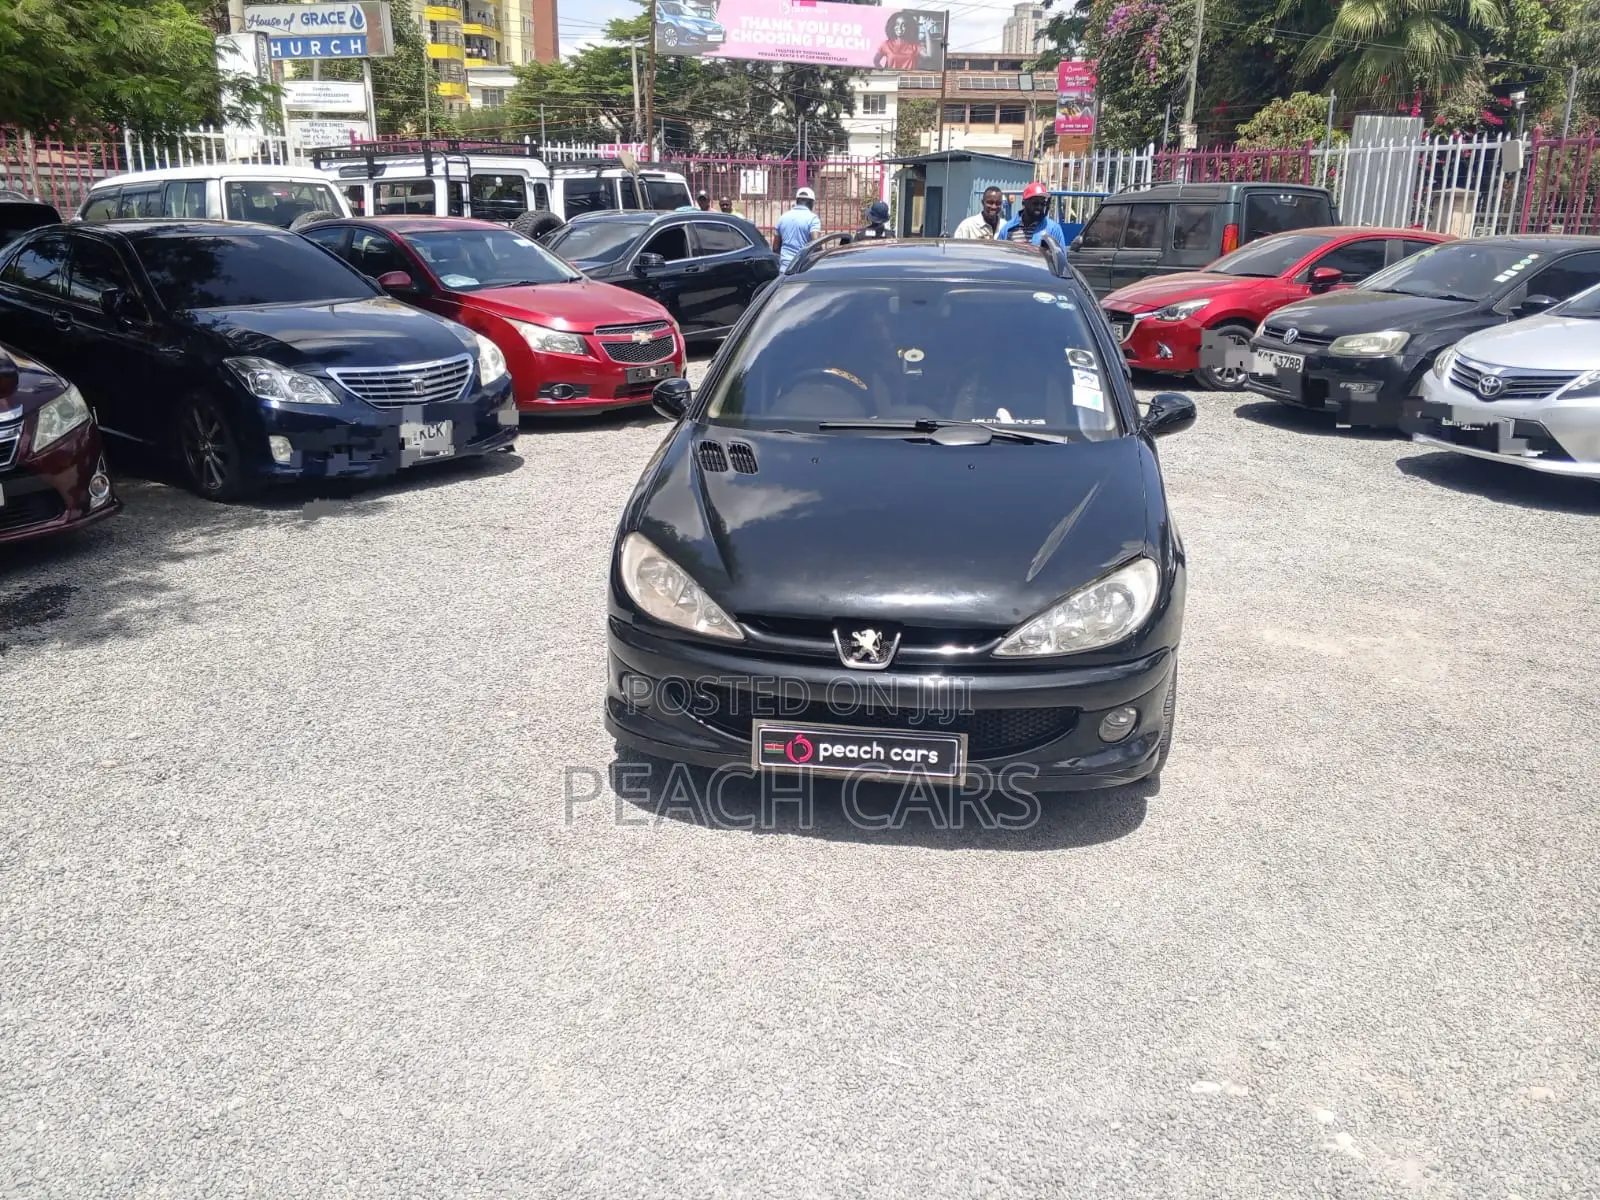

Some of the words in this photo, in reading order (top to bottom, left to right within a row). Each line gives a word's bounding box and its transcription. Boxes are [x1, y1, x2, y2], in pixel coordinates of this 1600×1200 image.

[246, 14, 281, 28] House
[283, 13, 295, 31] of
[300, 11, 346, 25] GRACE
[740, 16, 792, 31] THANK
[798, 20, 830, 34] YOU
[833, 23, 863, 37] FOR
[271, 39, 362, 56] HURCH
[730, 28, 813, 46] CHOOSING
[816, 35, 871, 51] PEACH!
[819, 741, 885, 762] peach
[890, 747, 939, 764] cars
